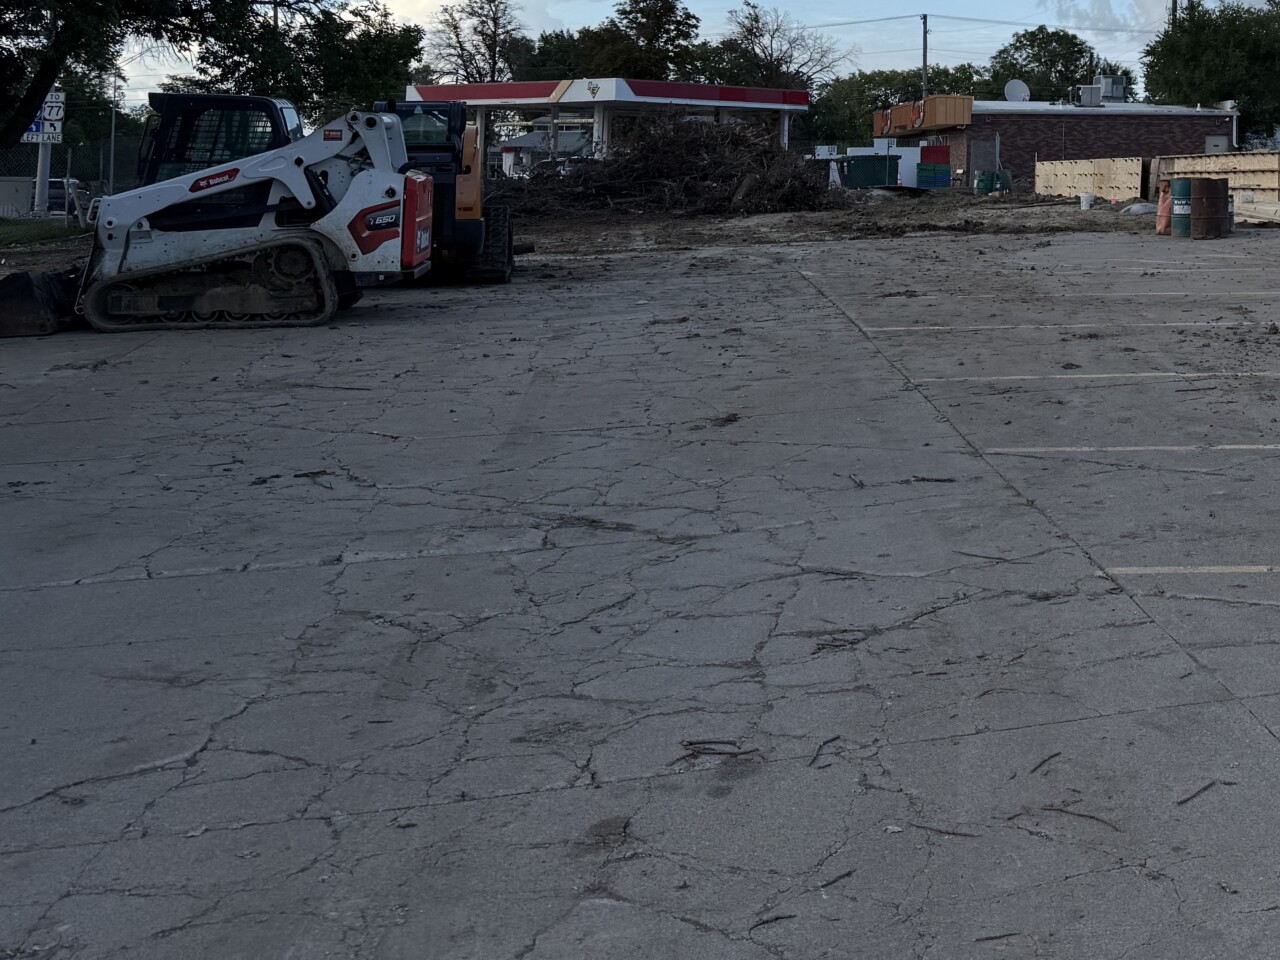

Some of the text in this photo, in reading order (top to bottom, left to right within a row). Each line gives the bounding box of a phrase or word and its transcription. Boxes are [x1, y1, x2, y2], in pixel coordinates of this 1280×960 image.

[46, 105, 62, 117] 77
[42, 134, 61, 142] LANE
[209, 175, 229, 185] Bobcat
